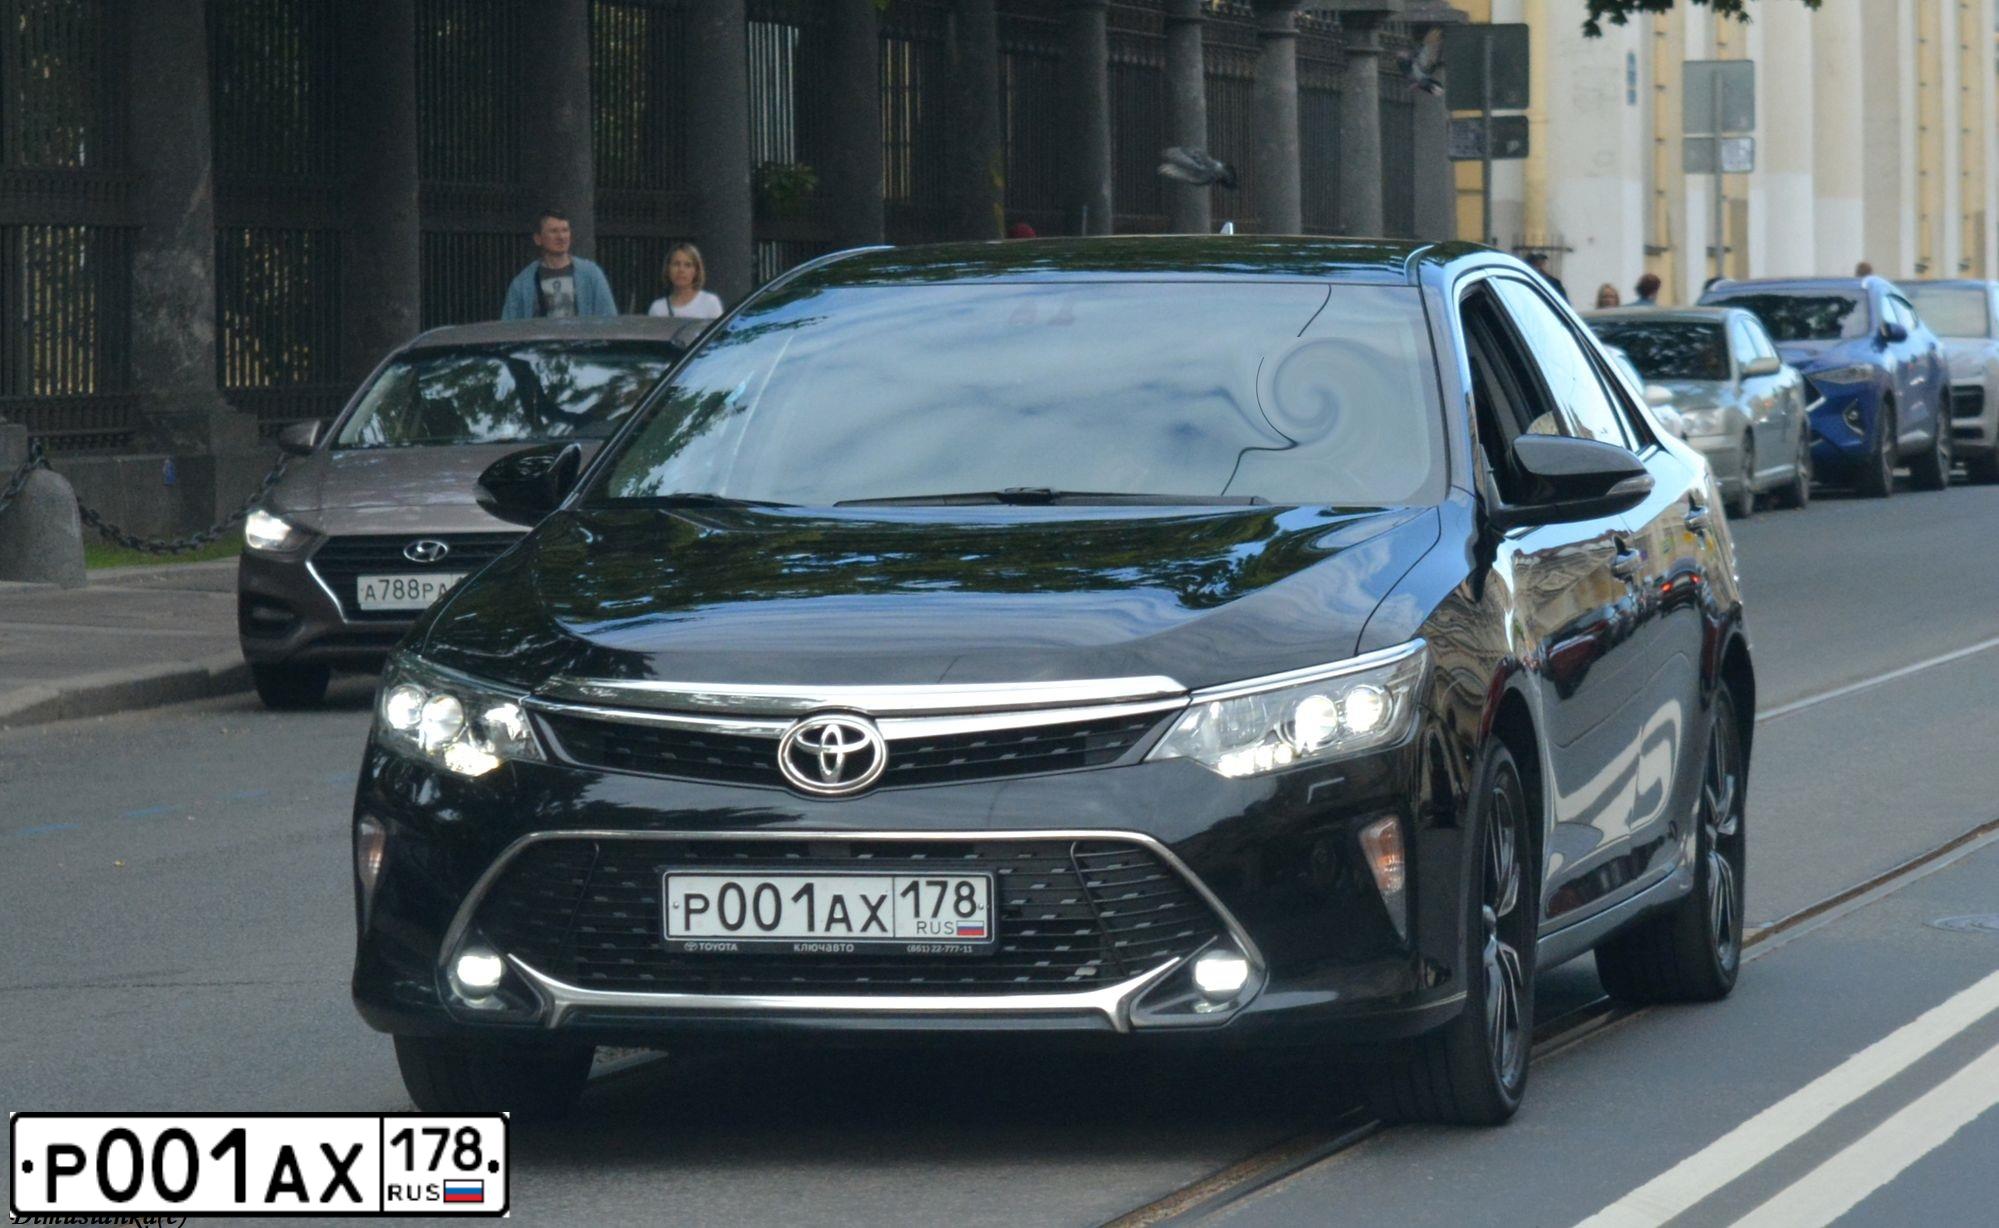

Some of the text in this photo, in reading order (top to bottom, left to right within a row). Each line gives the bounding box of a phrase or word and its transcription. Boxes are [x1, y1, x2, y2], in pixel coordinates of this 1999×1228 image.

[683, 880, 977, 933] P001AX 178
[916, 920, 954, 935] RUS
[699, 942, 739, 952] TOYOTA
